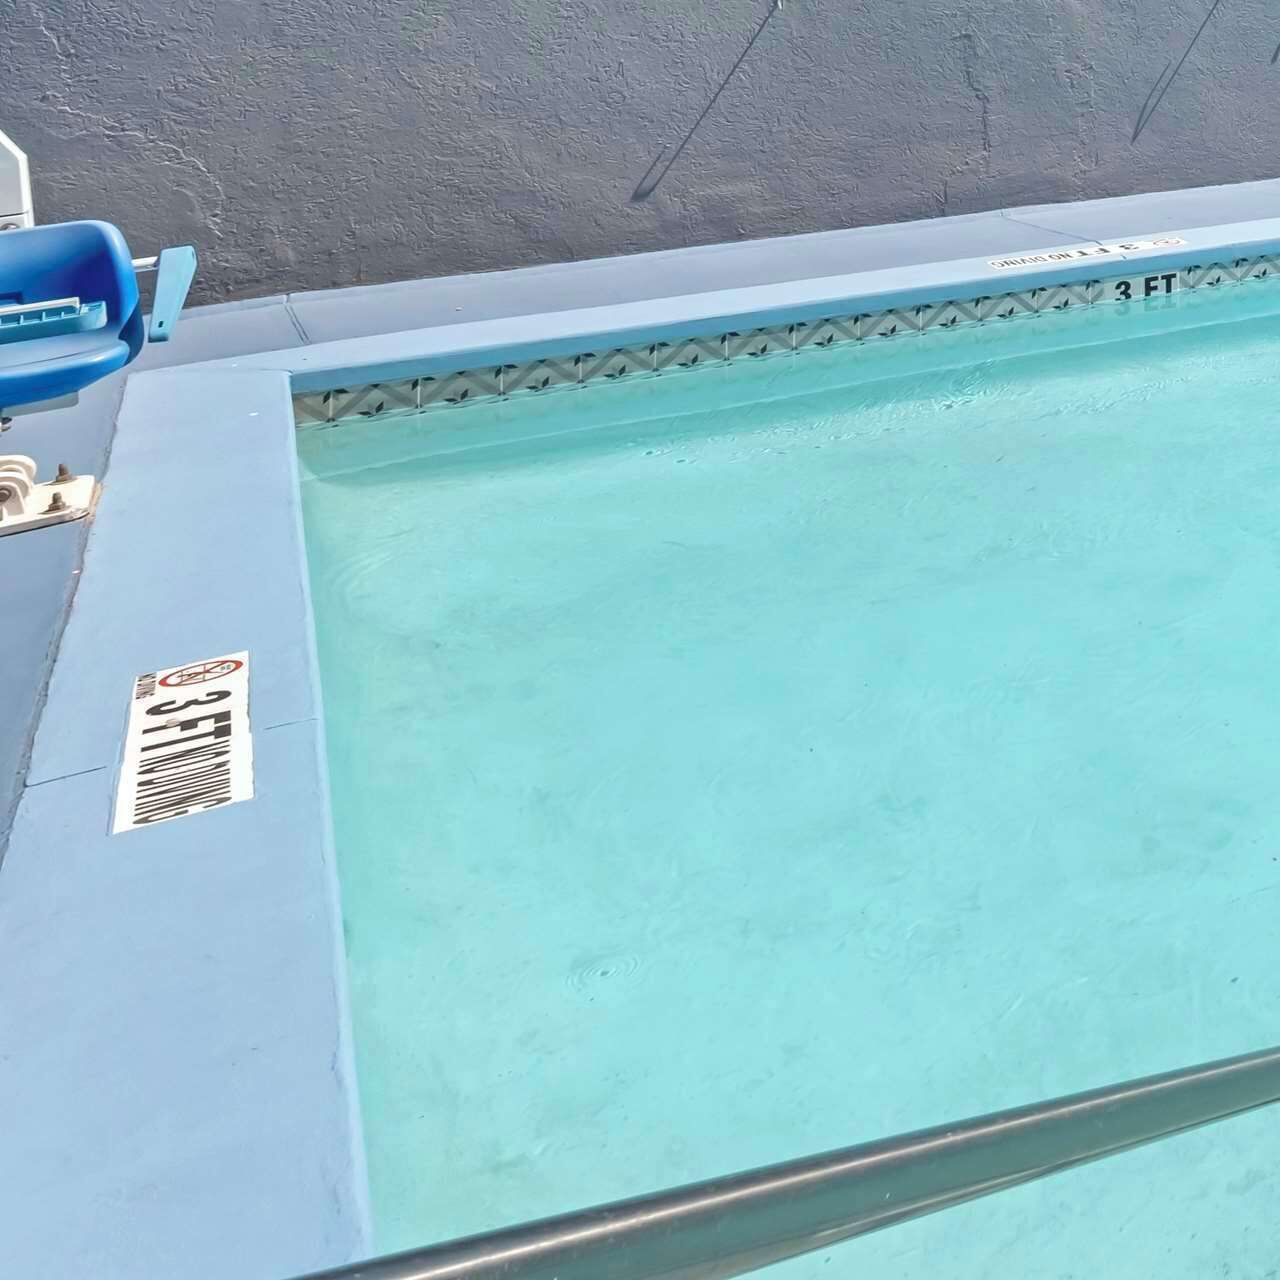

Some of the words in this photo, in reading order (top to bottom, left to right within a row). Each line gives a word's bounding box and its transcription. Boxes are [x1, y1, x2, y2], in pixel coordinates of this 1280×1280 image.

[1113, 280, 1132, 302] 3
[1143, 272, 1178, 297] FT
[145, 690, 232, 716] 3
[141, 709, 232, 753] FT
[136, 739, 232, 776] NO
[132, 760, 233, 825] DIVING
